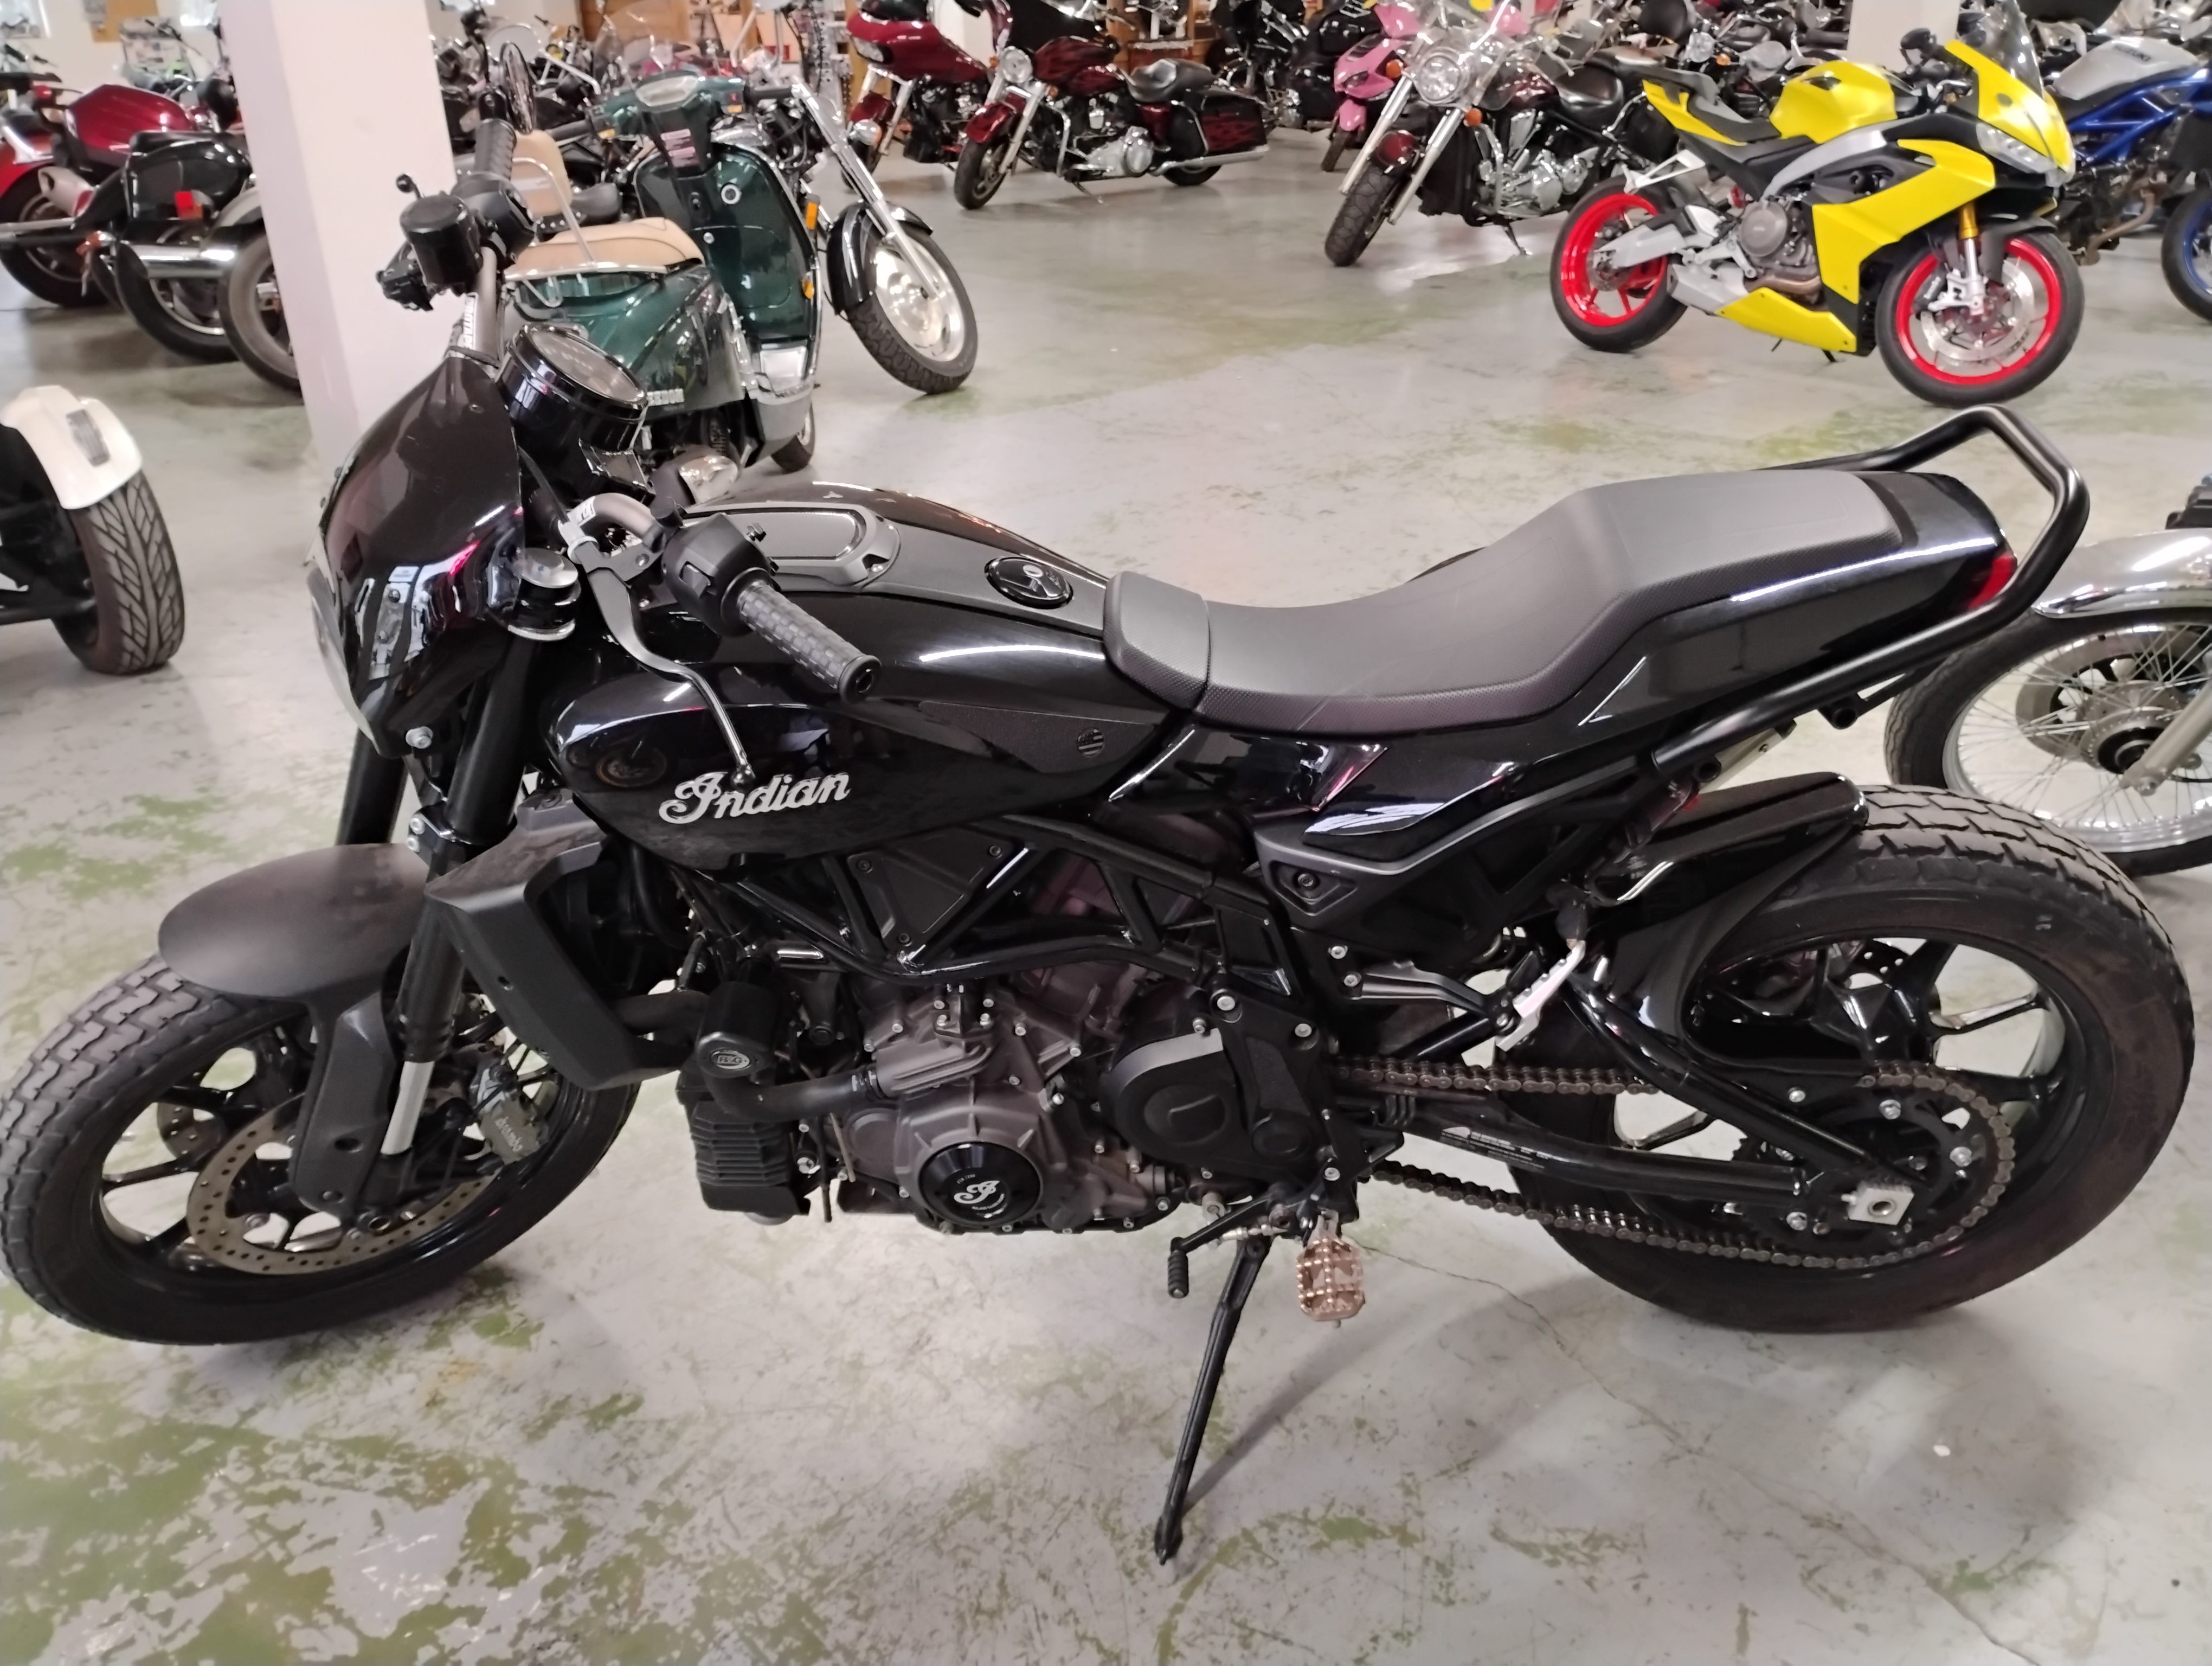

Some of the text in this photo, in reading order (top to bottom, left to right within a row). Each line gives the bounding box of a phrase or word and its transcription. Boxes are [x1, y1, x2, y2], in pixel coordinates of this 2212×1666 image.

[463, 296, 474, 349] PROTAPE
[658, 771, 851, 824] Indian
[494, 1116, 523, 1152] brembo
